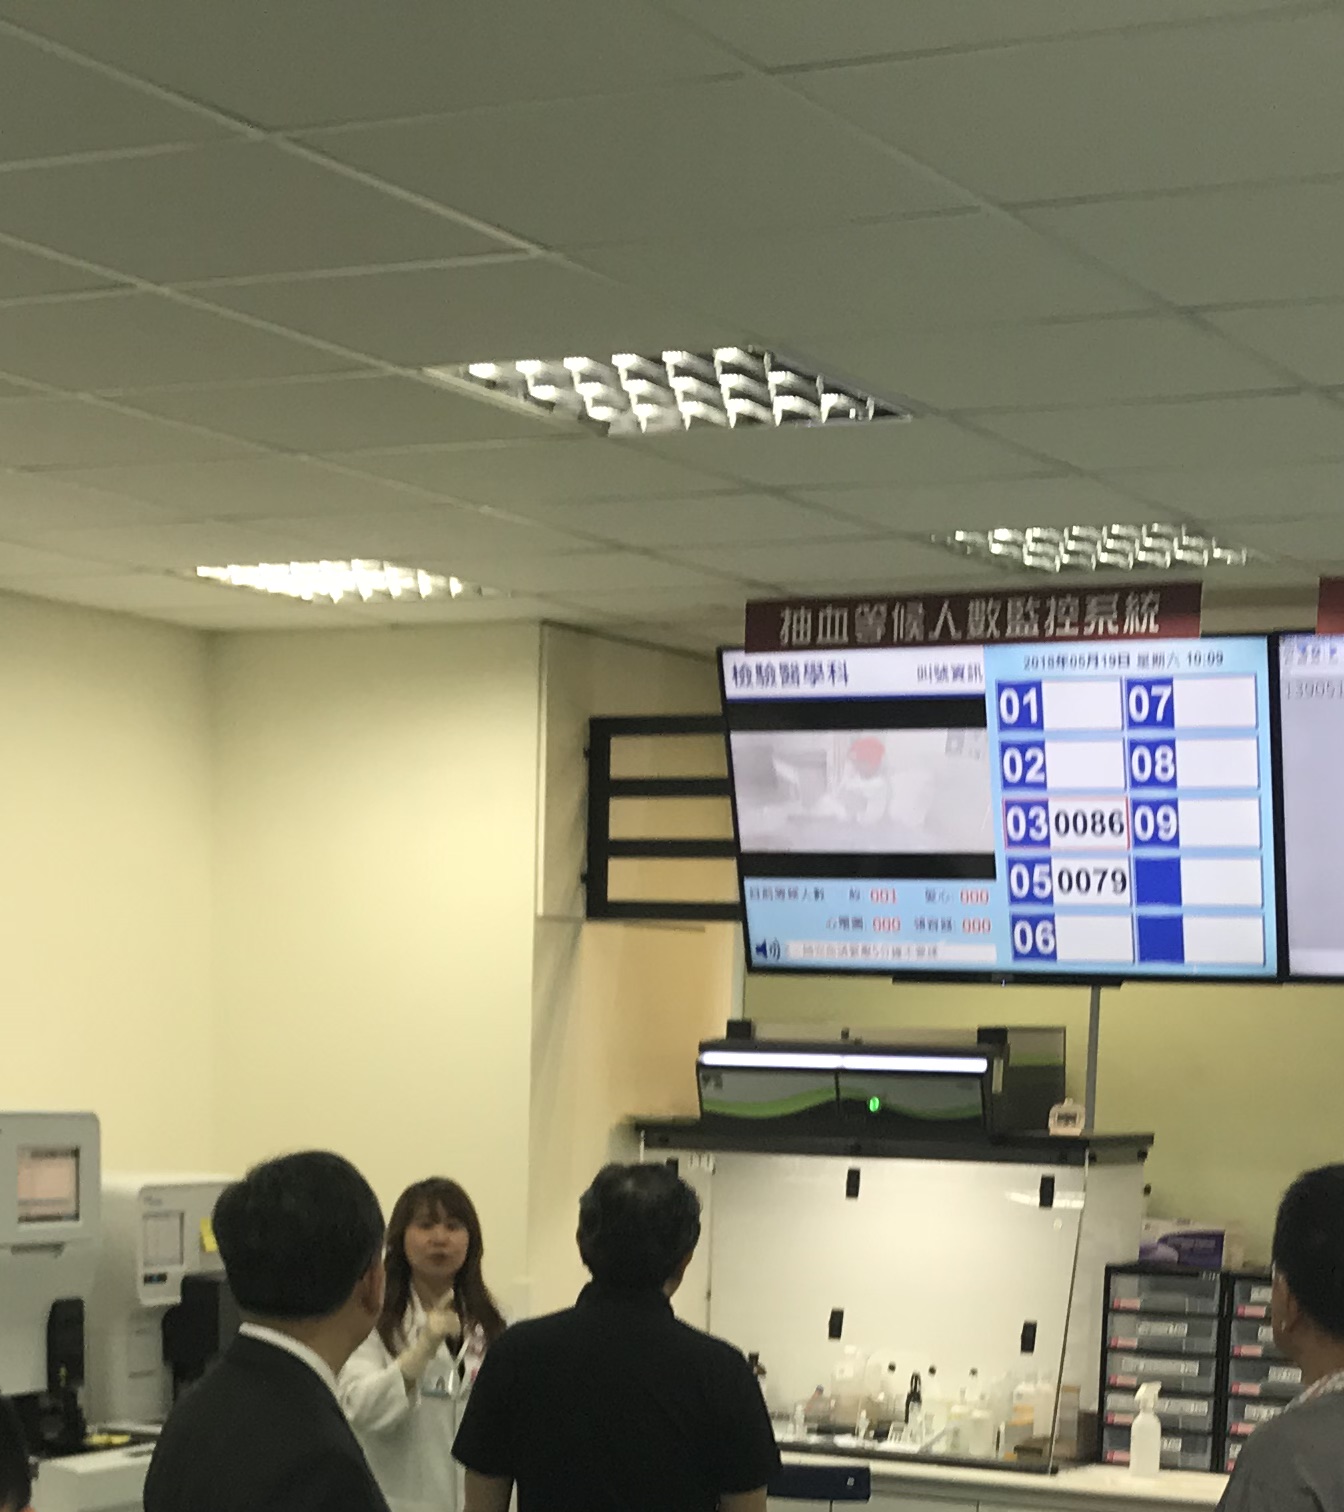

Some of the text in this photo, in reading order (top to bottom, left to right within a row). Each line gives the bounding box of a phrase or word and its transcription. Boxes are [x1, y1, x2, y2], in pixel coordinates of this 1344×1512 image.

[780, 590, 1160, 647] 抽血等候人數監控系統
[999, 687, 1038, 724] 01
[1128, 684, 1172, 722] 07
[1003, 747, 1045, 783] 02
[1131, 745, 1175, 783] 08
[1006, 805, 1125, 842] 03 0086
[1133, 805, 1178, 842] 09
[1009, 863, 1127, 899] 05 0079
[1013, 920, 1055, 954] 06
